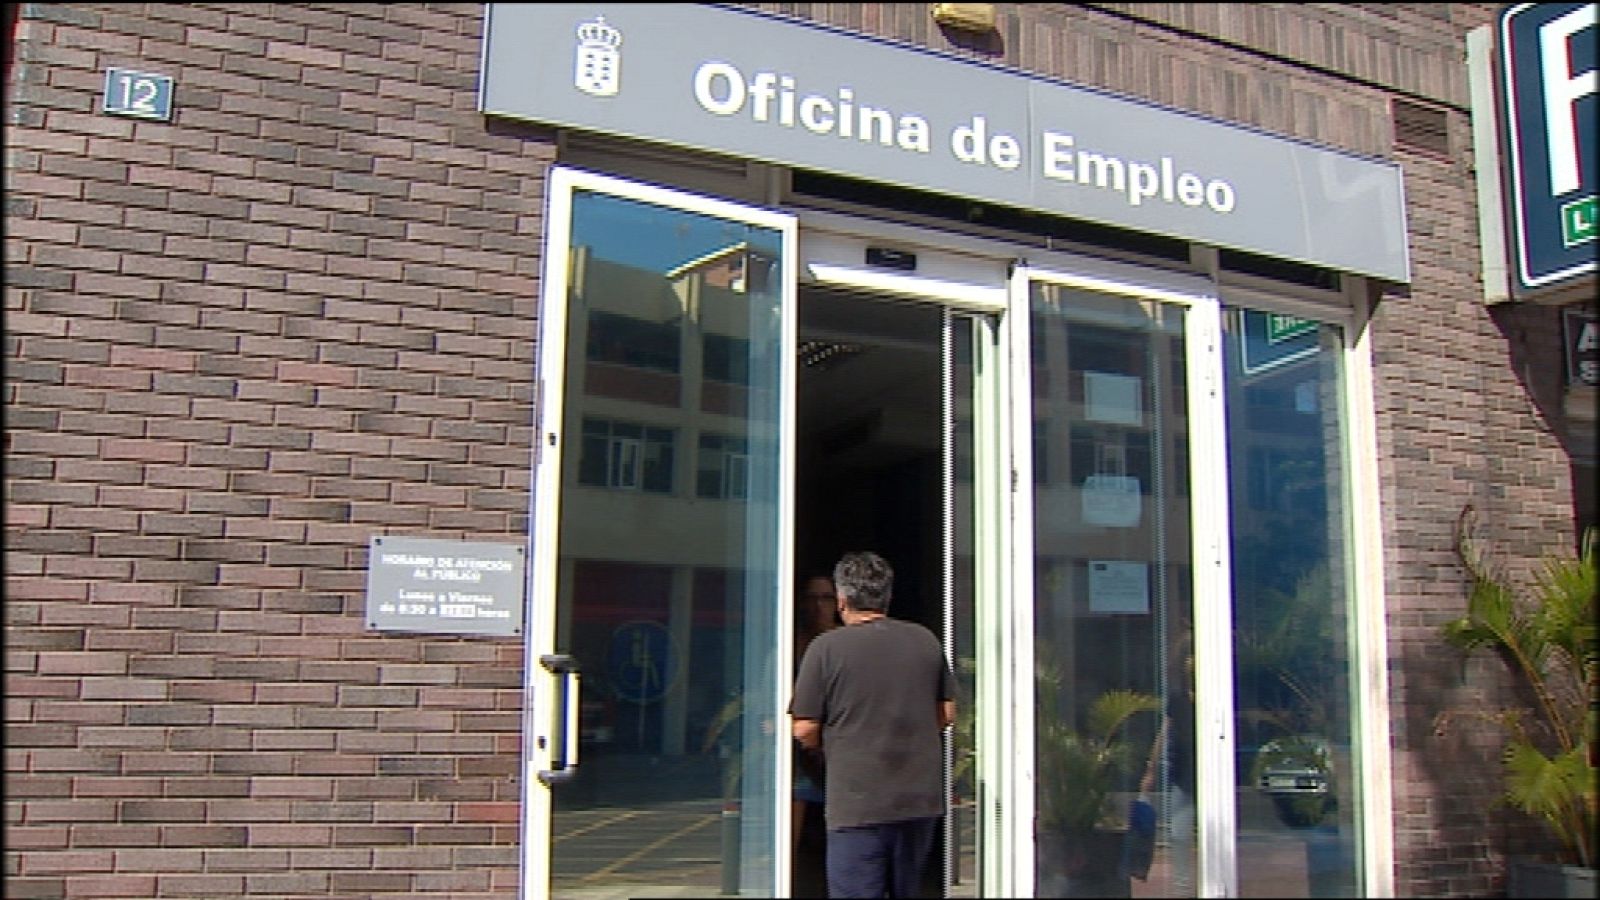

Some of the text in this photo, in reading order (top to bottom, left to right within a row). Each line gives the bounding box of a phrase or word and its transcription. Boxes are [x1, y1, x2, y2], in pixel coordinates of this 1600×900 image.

[120, 76, 157, 112] 12
[694, 61, 1235, 213] Oficina de Empleo
